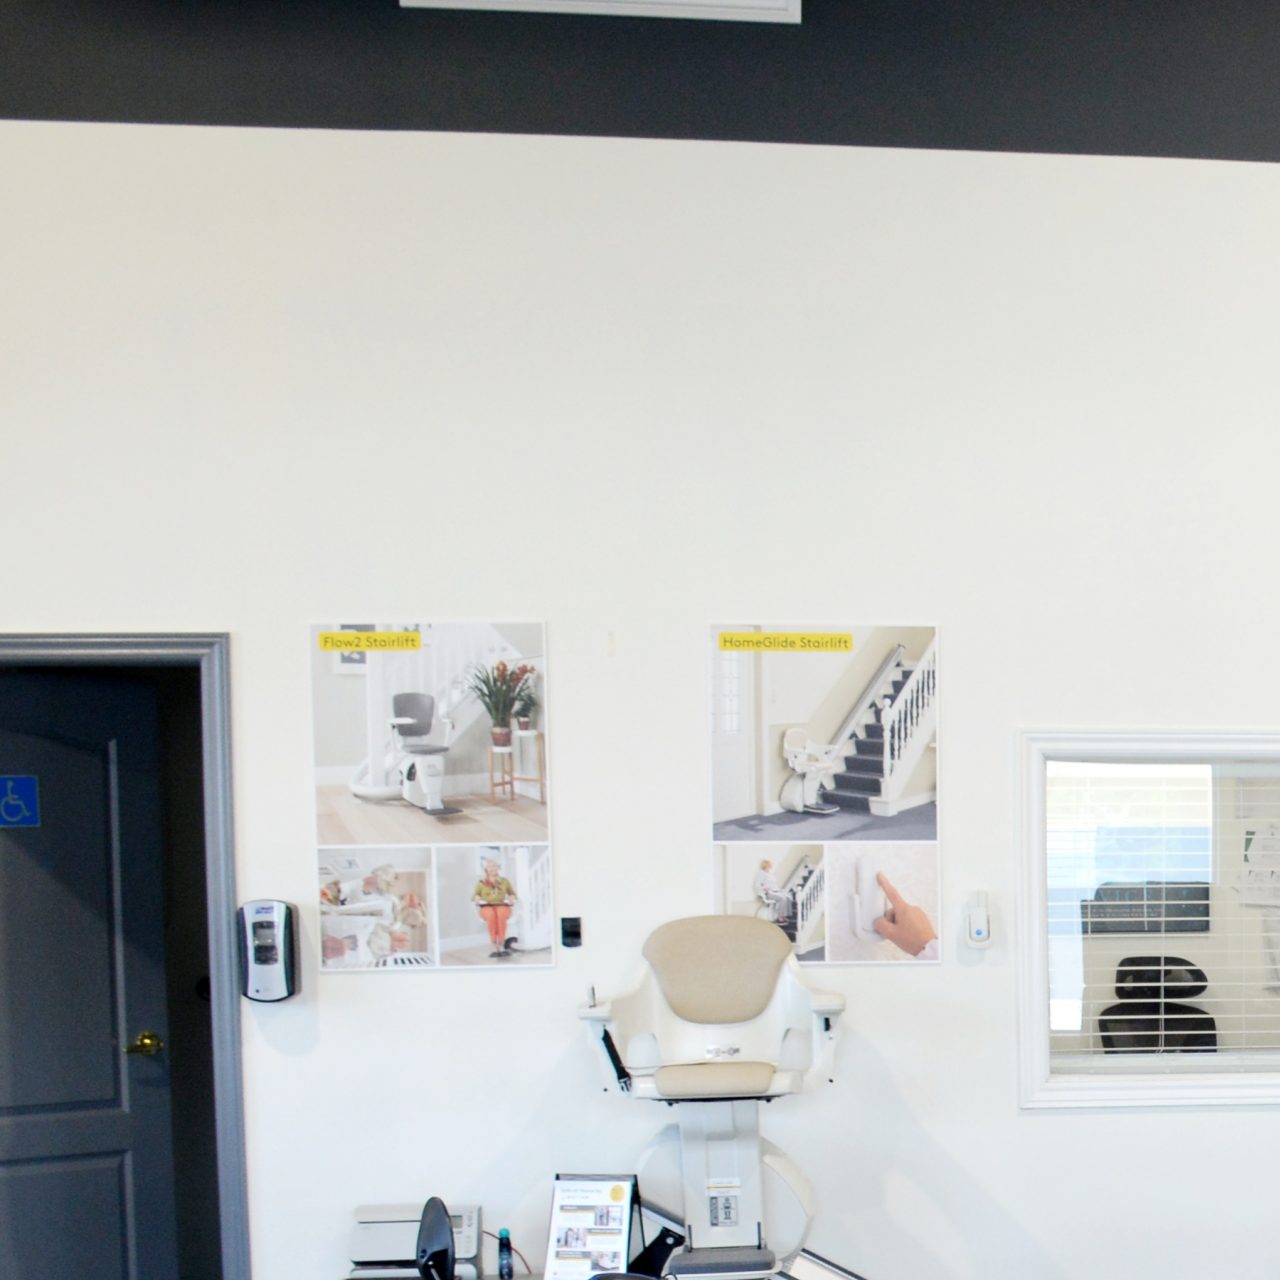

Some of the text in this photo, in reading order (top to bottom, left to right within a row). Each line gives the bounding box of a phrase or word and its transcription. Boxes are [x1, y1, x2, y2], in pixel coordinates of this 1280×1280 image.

[323, 635, 417, 648] Flow2 Stairlift
[722, 636, 849, 649] HomeGlide Stairlift
